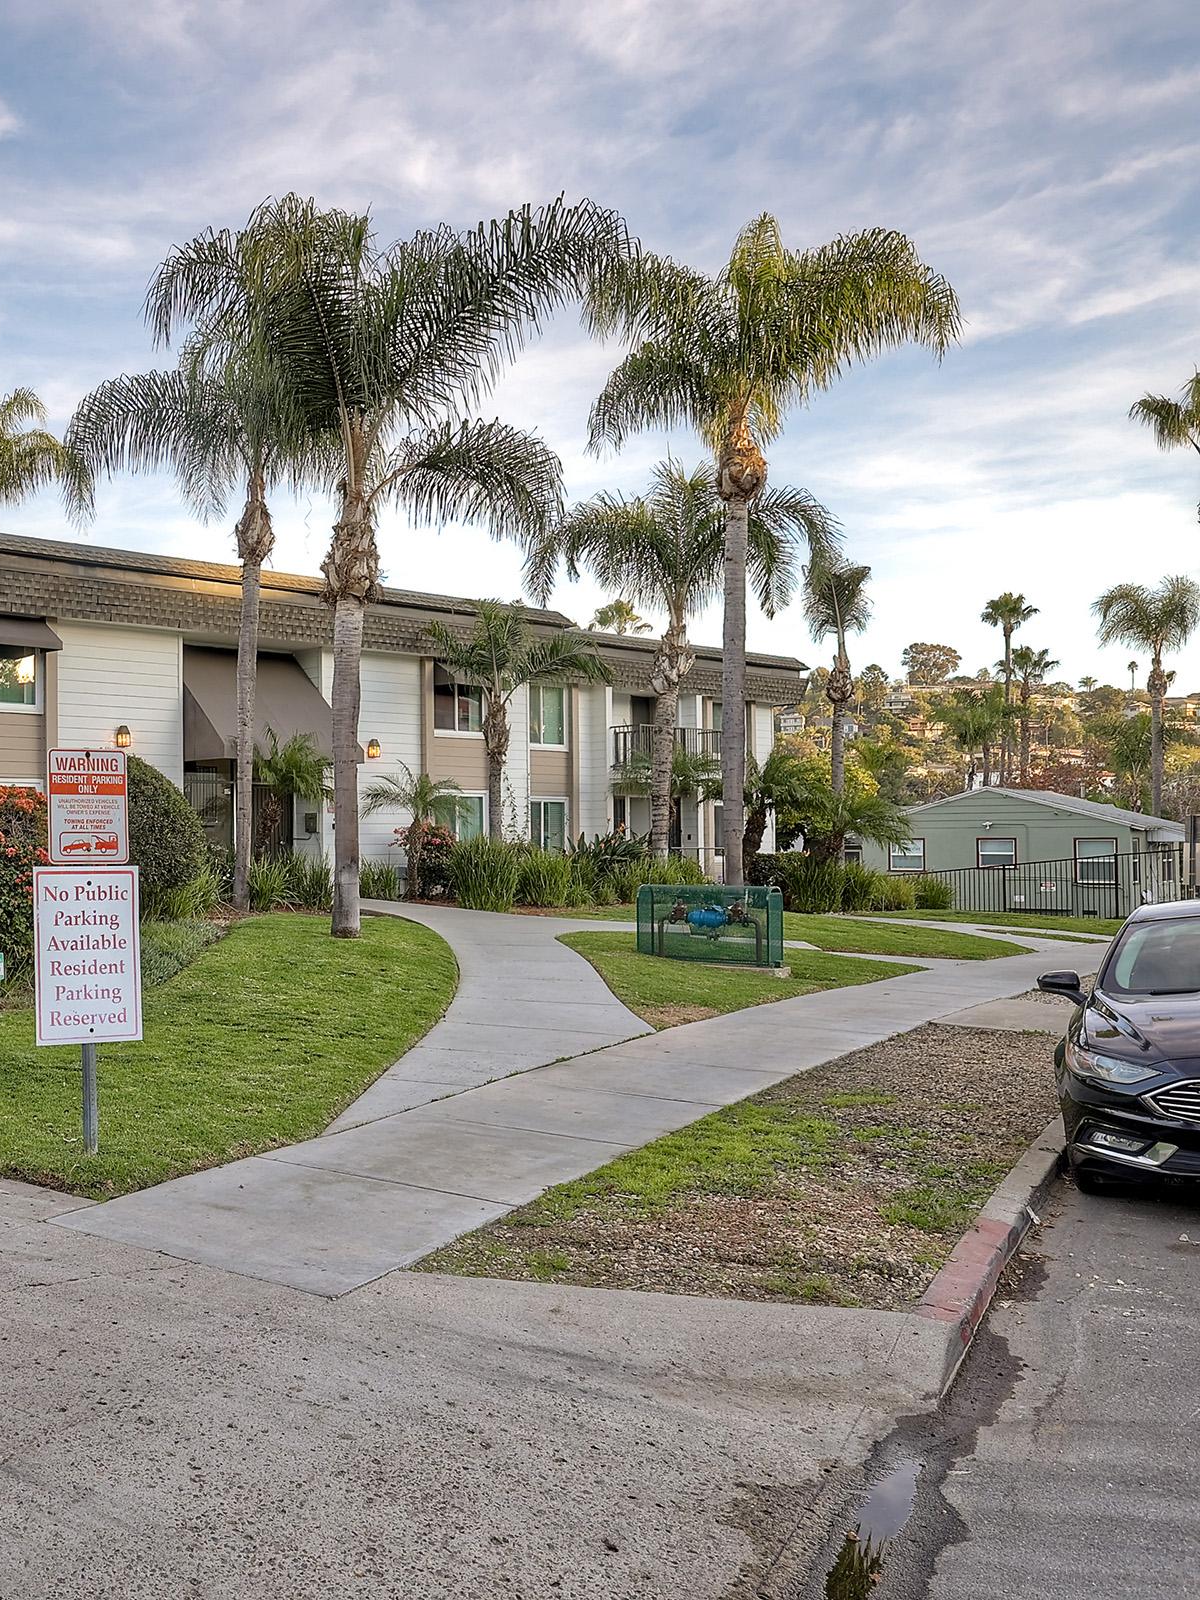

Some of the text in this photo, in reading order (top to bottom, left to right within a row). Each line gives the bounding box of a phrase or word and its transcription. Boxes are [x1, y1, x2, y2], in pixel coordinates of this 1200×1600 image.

[55, 757, 119, 772] WARNING
[52, 775, 123, 785] RESIDENT PARKING
[78, 785, 98, 794] ONLY
[44, 885, 128, 902] No Public
[53, 910, 120, 930] Parking
[47, 934, 127, 951] Available
[50, 959, 126, 976] Resident
[55, 984, 122, 1003] Parking
[50, 1008, 127, 1026] Reserved
